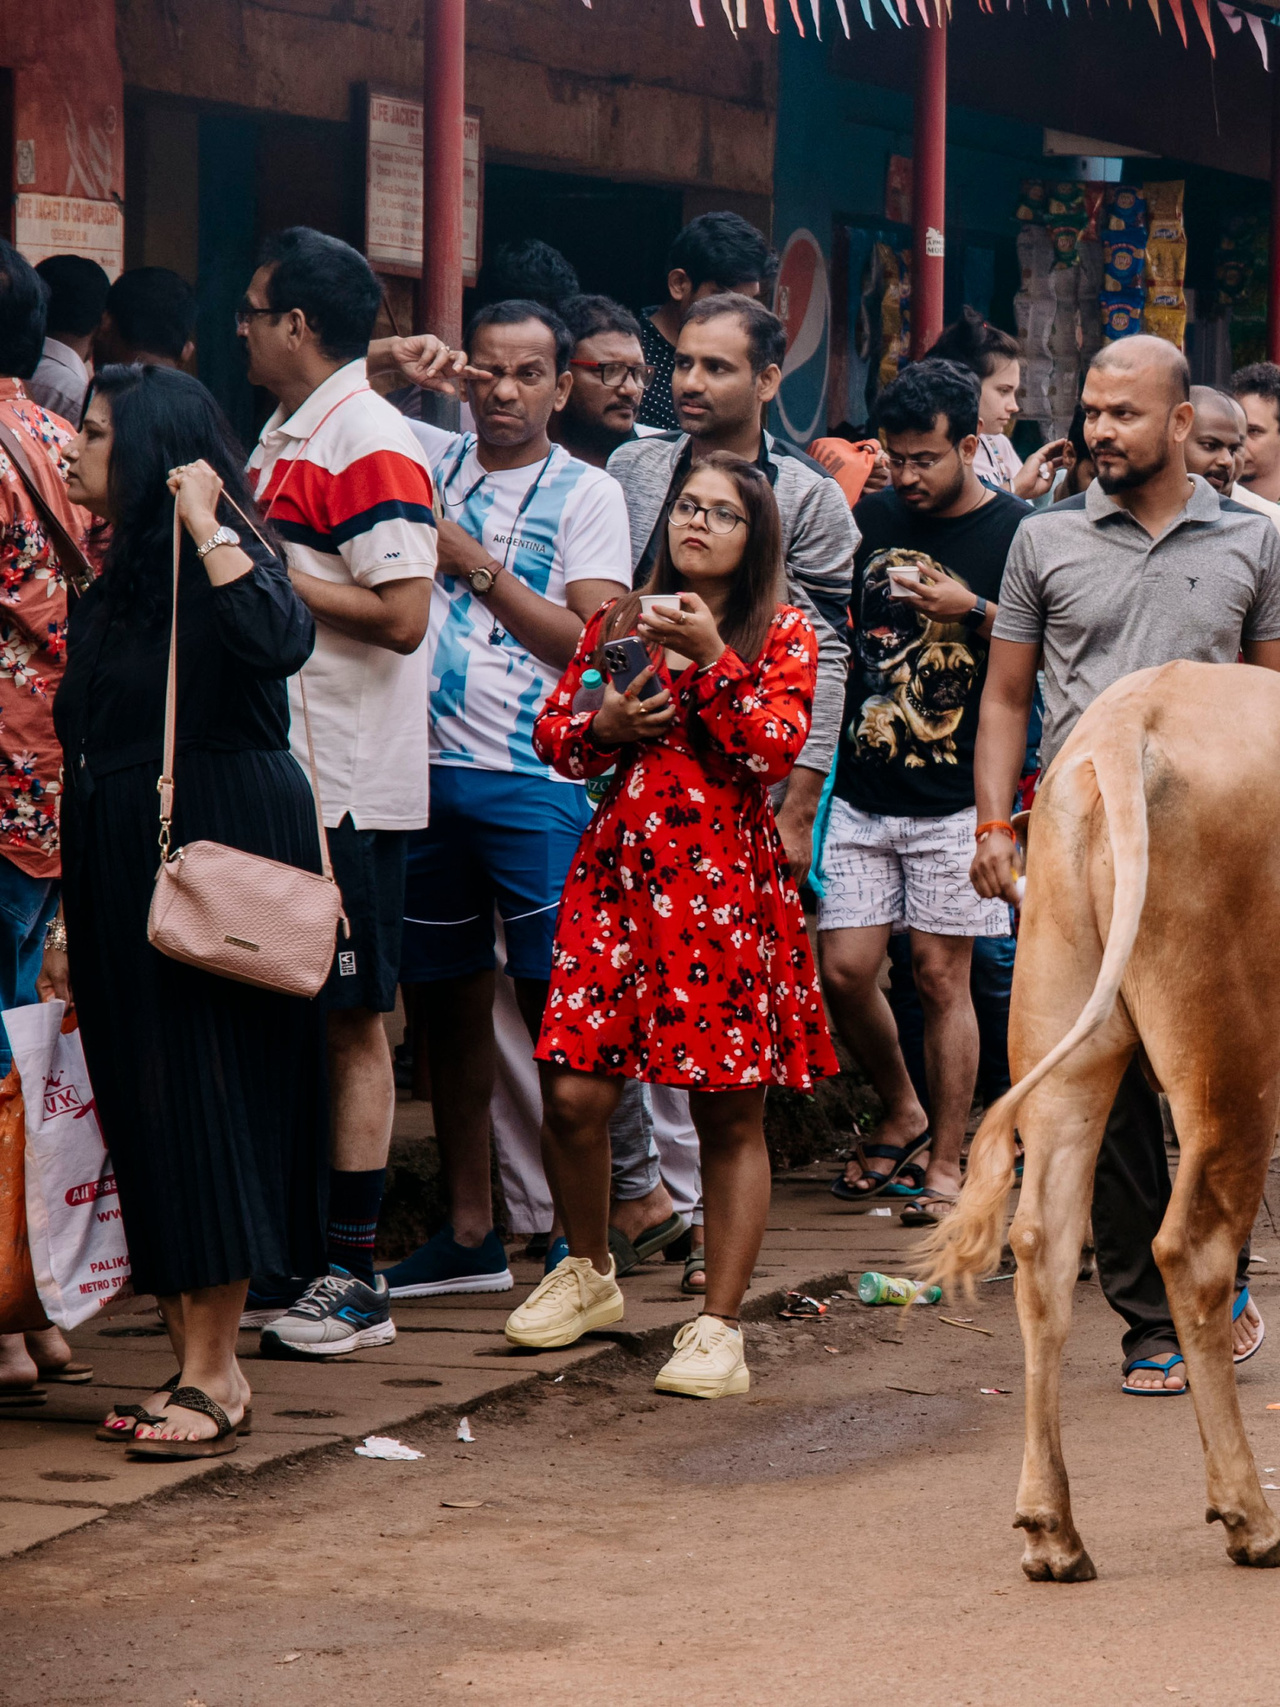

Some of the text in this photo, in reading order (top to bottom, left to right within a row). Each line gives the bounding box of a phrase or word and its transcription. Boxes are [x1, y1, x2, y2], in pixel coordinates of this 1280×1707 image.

[371, 100, 420, 129] LIFE JACKET
[493, 533, 547, 554] ARGENTINA
[72, 1185, 90, 1203] All
[79, 1279, 110, 1295] METRO
